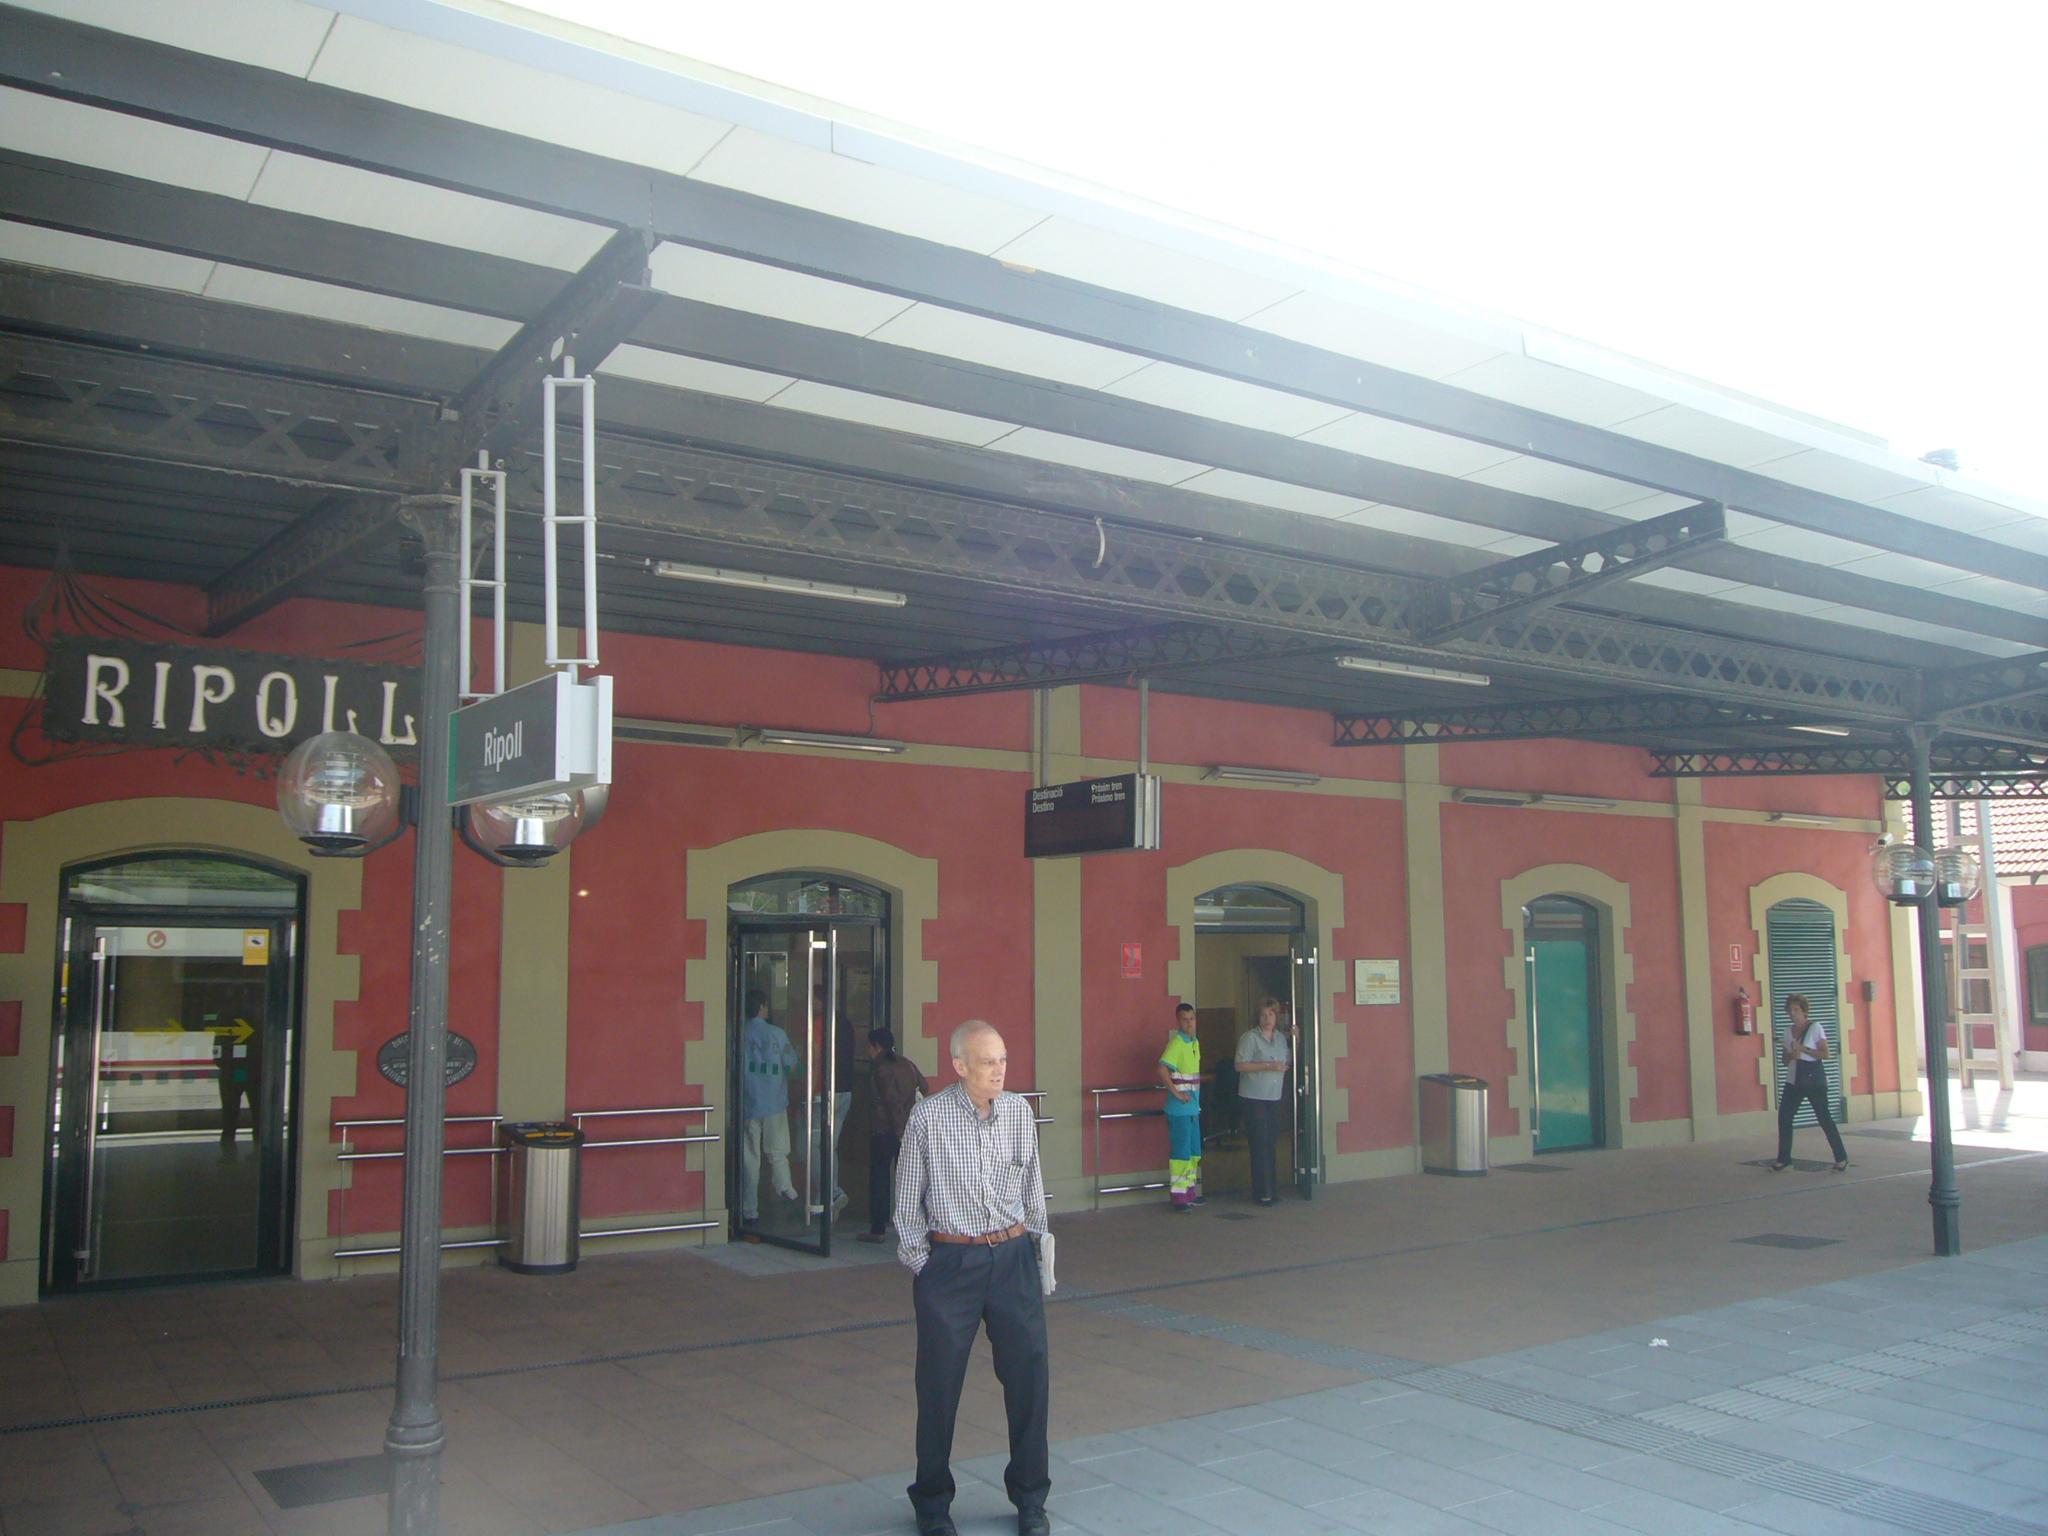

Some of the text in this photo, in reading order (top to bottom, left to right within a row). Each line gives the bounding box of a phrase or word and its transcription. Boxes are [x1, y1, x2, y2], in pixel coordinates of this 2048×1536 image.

[81, 654, 417, 746] RIPOLL
[484, 720, 523, 773] Ripoll
[1032, 802, 1054, 813] Destino
